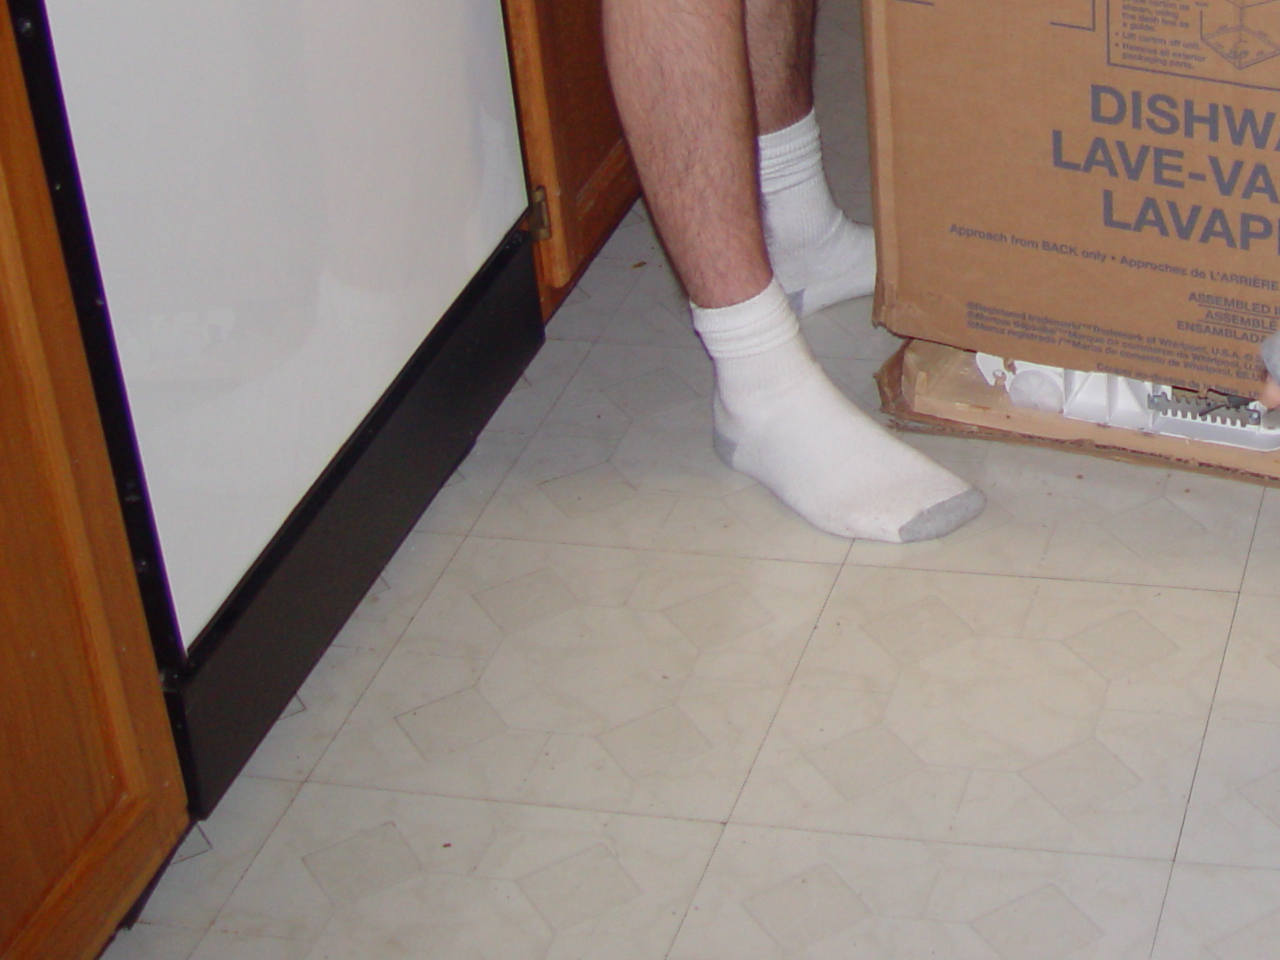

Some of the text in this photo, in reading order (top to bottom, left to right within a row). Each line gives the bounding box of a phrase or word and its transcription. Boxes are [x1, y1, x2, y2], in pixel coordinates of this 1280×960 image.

[950, 224, 1008, 243] Approach
[1010, 235, 1039, 249] from
[1042, 240, 1079, 257] BACK
[1081, 249, 1107, 263] only
[1119, 255, 1187, 276] Approchez
[1190, 268, 1206, 279] de
[1188, 291, 1271, 314] ASSEMBLED
